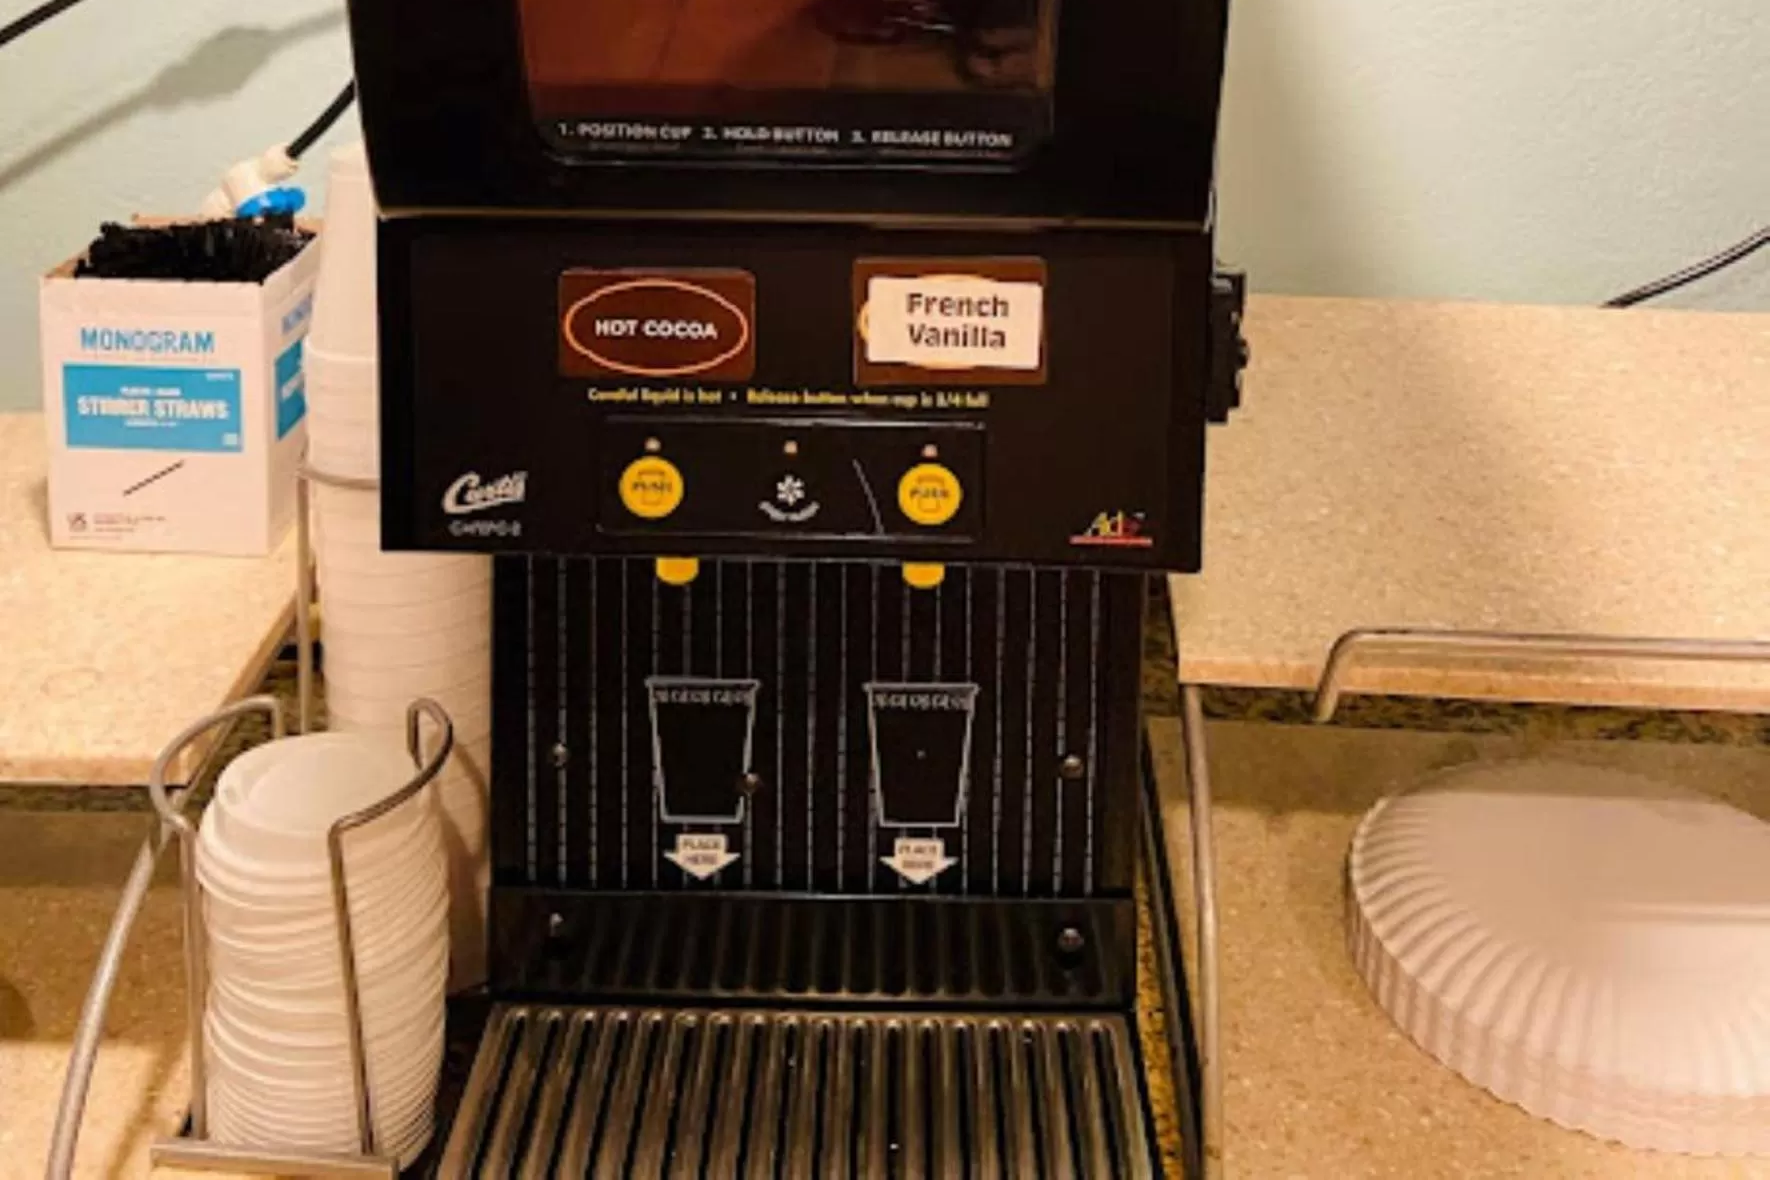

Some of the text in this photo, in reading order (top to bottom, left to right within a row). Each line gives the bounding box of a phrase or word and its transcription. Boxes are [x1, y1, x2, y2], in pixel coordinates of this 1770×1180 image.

[558, 123, 575, 136] 1.
[576, 122, 657, 140] POSITION
[659, 124, 693, 141] CUP
[722, 126, 770, 141] HOLD
[772, 126, 840, 143] BUTTON
[871, 129, 941, 146] RELEASE
[943, 130, 1013, 148] BUTTON
[906, 292, 1011, 320] French
[80, 327, 215, 354] MONOGRAM
[595, 318, 719, 341] HOT COCOA
[908, 322, 1008, 350] Vanilla
[153, 398, 231, 419] STRAWS
